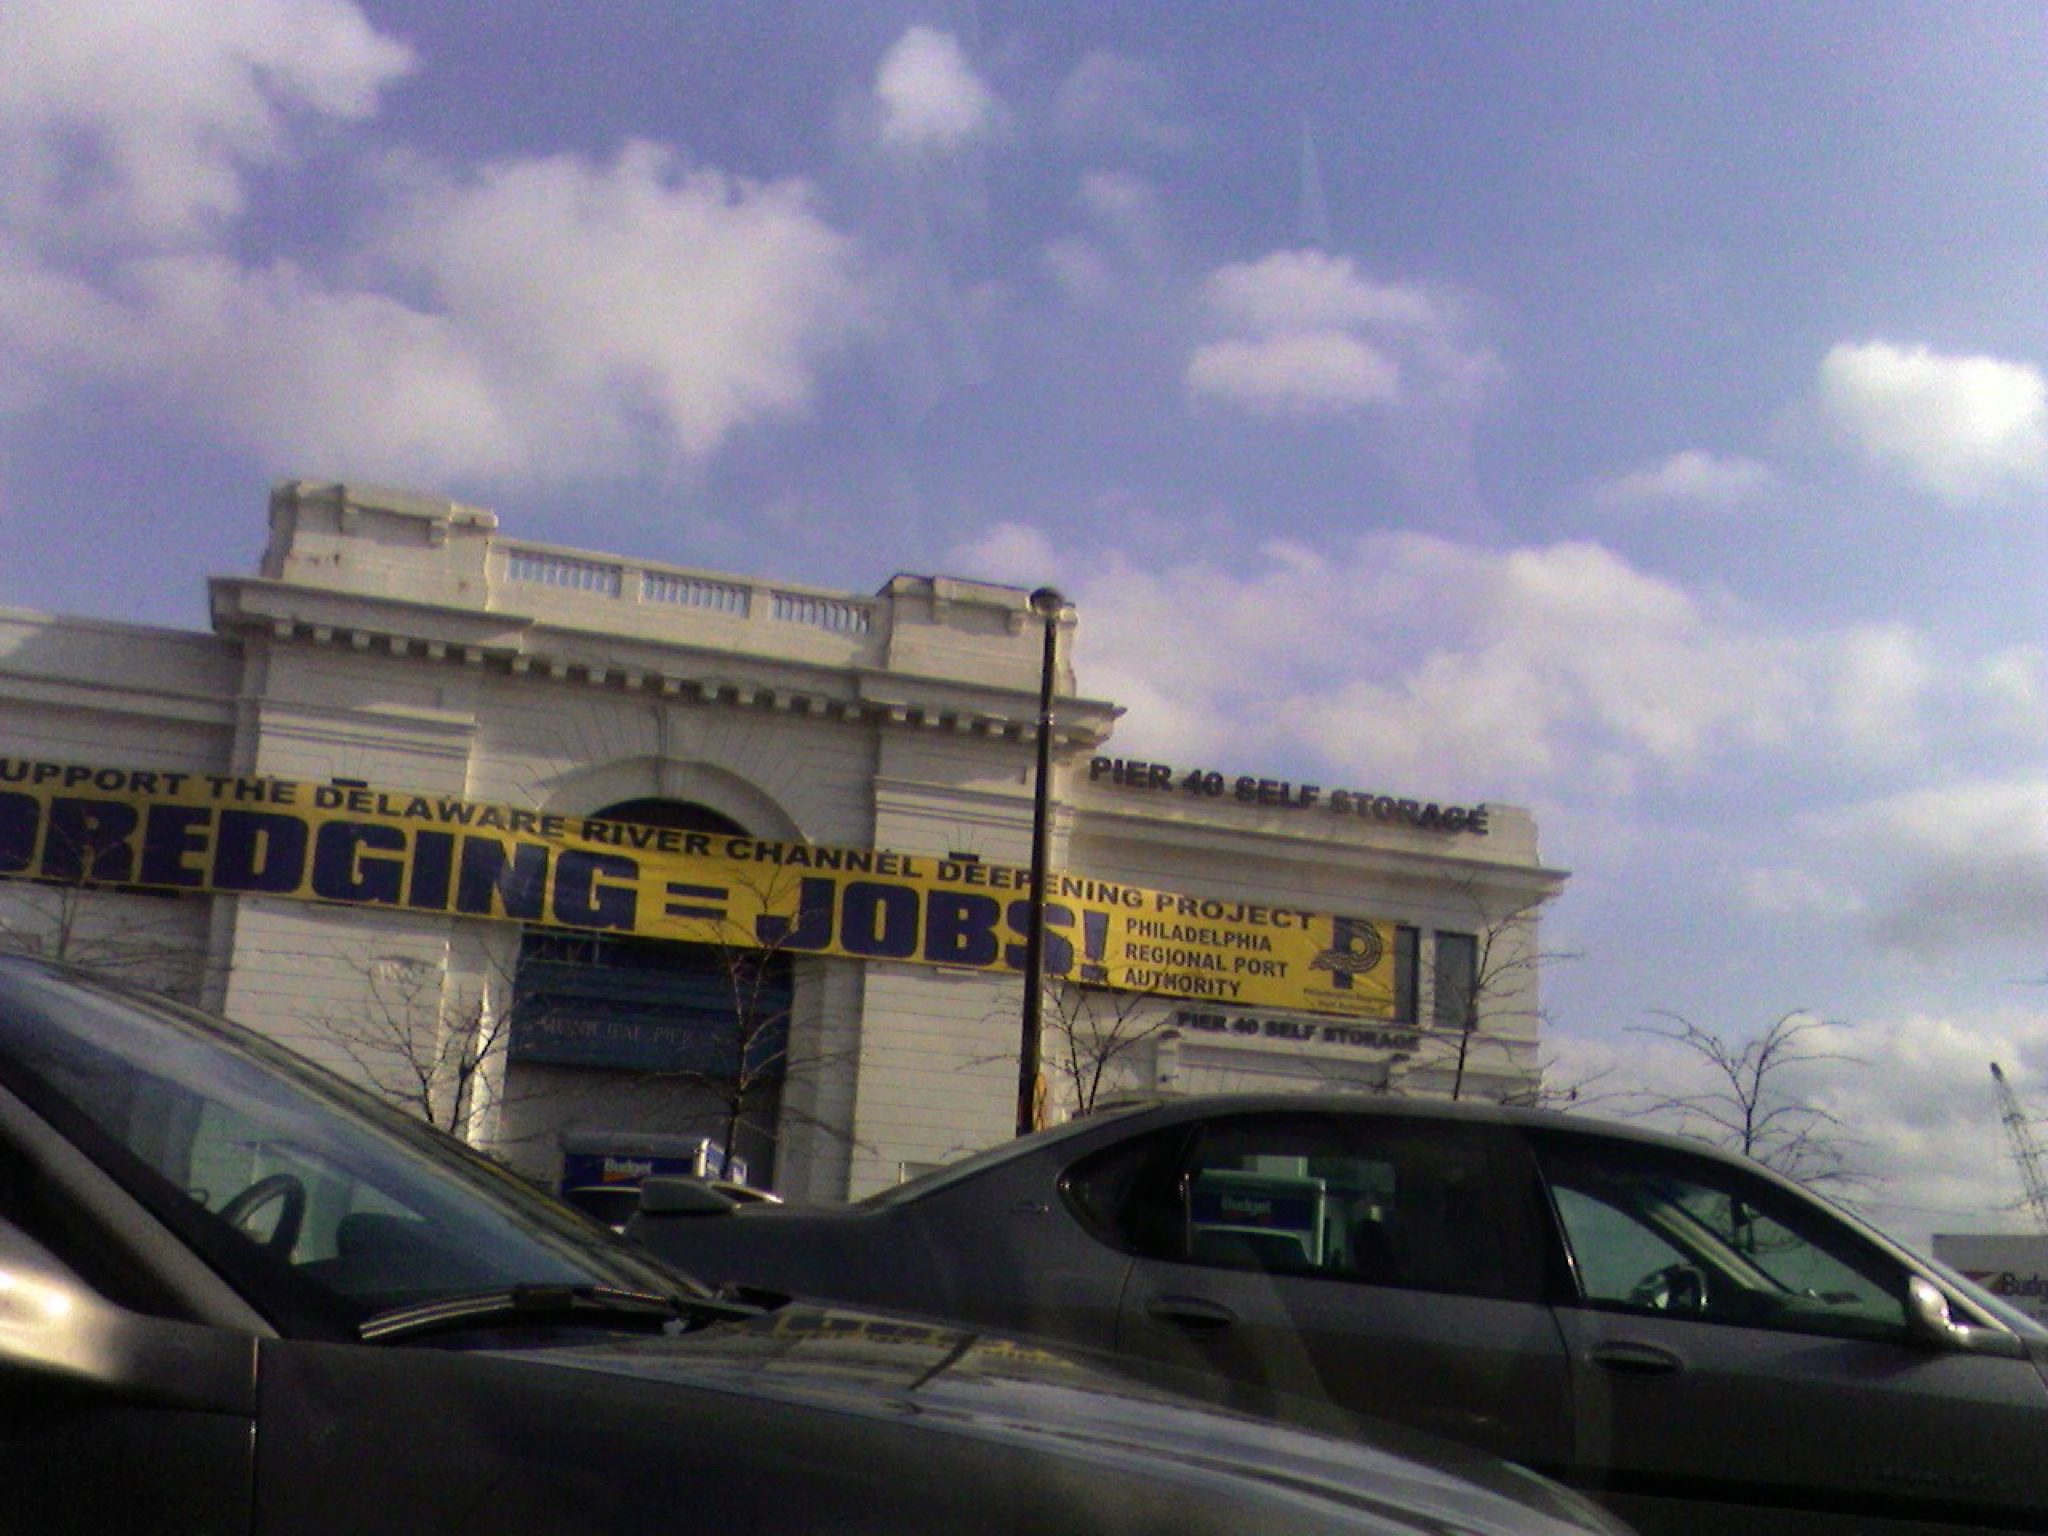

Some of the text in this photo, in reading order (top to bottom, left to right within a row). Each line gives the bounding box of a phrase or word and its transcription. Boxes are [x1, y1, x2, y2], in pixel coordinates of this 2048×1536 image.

[1090, 756, 1488, 834] PIER 40 SELF STORAGE
[207, 775, 298, 803] THE
[315, 786, 565, 838] DELAWARE
[582, 820, 711, 856] RIVER
[726, 838, 923, 878] CHANNEL
[938, 860, 1144, 908] DEEPENING
[1154, 894, 1316, 930] PROJECT
[756, 876, 1110, 983] JOBS!
[1125, 917, 1273, 953] PHILADELPHIA
[1124, 967, 1243, 998] AUTHORITY
[1125, 942, 1289, 979] REGIONAL PORT
